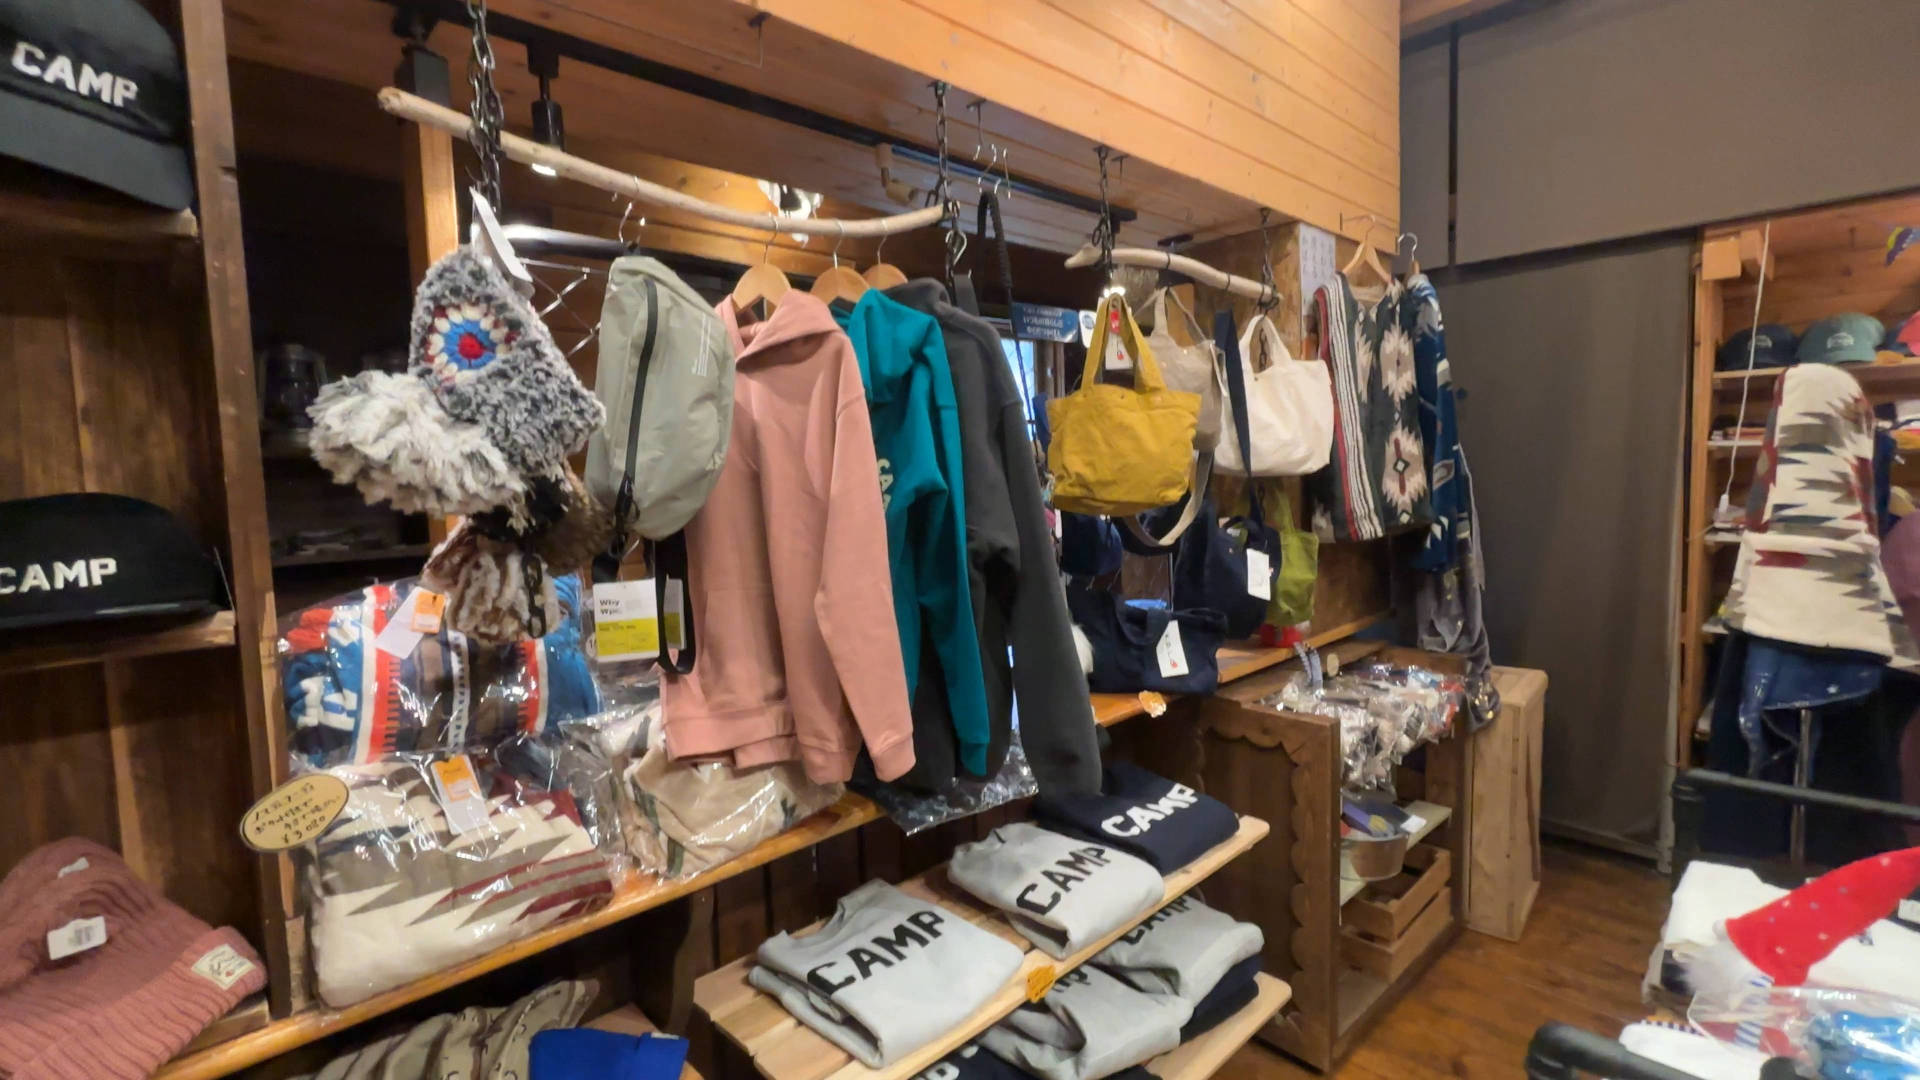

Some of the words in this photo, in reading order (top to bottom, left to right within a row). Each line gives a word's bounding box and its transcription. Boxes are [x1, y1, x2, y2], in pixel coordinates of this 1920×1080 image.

[11, 41, 138, 107] CAMP
[1101, 783, 1199, 837] CAMP
[1016, 847, 1111, 915] CAMP
[807, 911, 945, 986] CAMP
